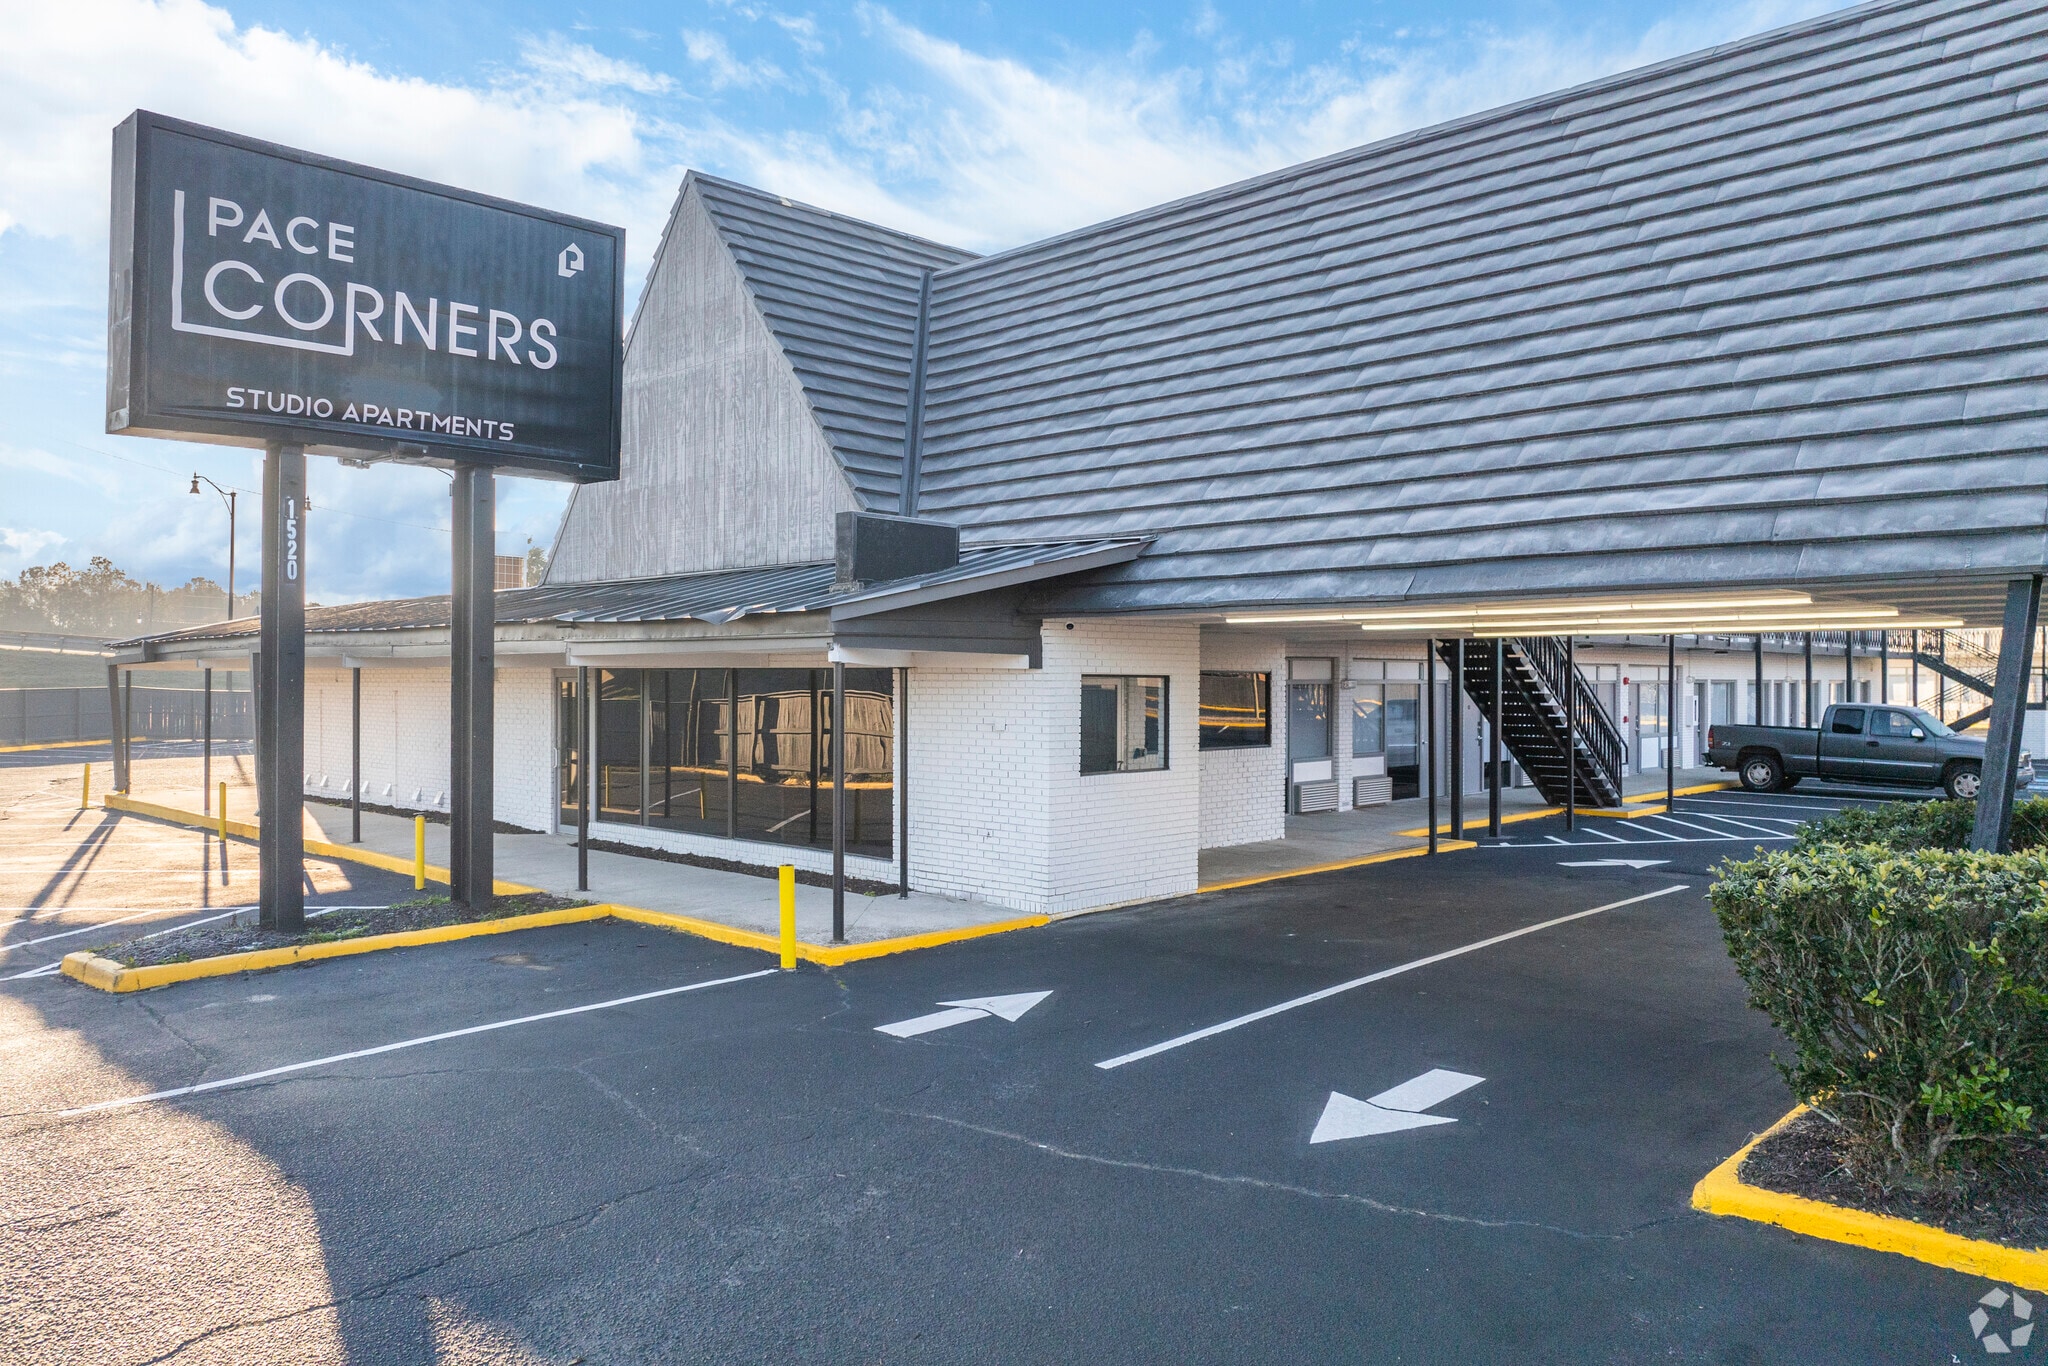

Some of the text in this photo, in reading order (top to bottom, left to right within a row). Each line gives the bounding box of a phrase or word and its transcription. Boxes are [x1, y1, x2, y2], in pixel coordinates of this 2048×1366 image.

[208, 196, 355, 263] PACE
[203, 260, 558, 370] CORNERS
[226, 387, 515, 441] STUDIO APARTMENTS
[286, 499, 298, 580] 1520
